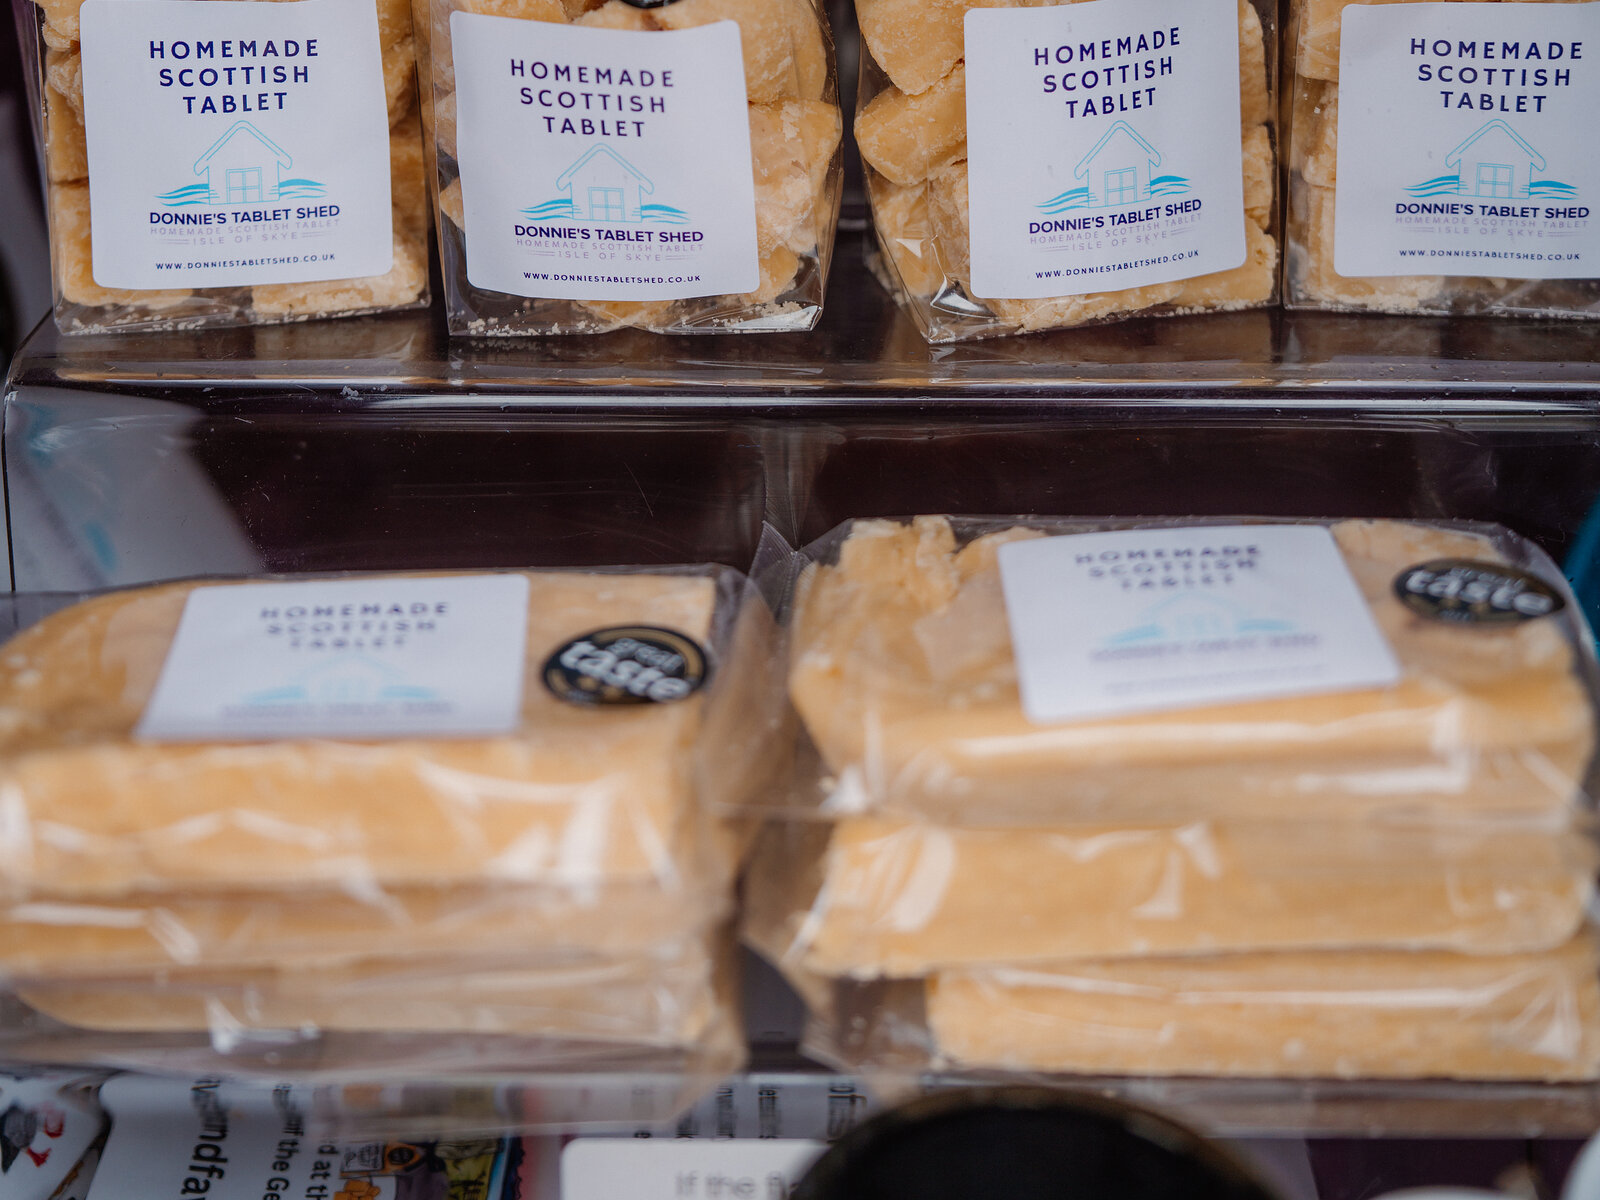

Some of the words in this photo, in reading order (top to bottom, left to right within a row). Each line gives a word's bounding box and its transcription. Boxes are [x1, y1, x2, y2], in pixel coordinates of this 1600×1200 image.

[149, 39, 318, 60] HOMEMADE
[1034, 26, 1180, 66] HOMEMADE
[1410, 38, 1582, 60] HOMEMADE
[159, 65, 308, 87] SCOTTISH
[510, 58, 674, 88] HOMEMADE
[1043, 56, 1172, 93] SCOTTISH
[1418, 64, 1570, 86] SCOTTISH
[182, 92, 288, 114] TABLET
[520, 87, 665, 113] SCOTTISH
[1065, 87, 1156, 118] TABLET
[1440, 91, 1546, 113] TABLET
[542, 116, 645, 138] TABLET
[149, 212, 227, 225] DONNIE'S
[232, 208, 291, 224] TABLET
[296, 205, 340, 219] SHED
[1029, 216, 1105, 234] DONNIE'S
[1109, 207, 1162, 226] TABLET
[1165, 199, 1202, 216] SHED
[1395, 203, 1474, 215] DONNIE'S
[1479, 205, 1540, 218] TABLET
[1544, 207, 1590, 218] SHED
[150, 226, 222, 236] HOMEMADE
[227, 222, 289, 234] SCOTTISH
[296, 218, 340, 230] TABLET
[1030, 230, 1099, 244] HOMEMADE
[1105, 222, 1160, 237] SCOTTISH
[1165, 213, 1202, 227] TABLET
[1396, 216, 1467, 225] HOMEMADE
[1474, 218, 1536, 227] SCOTTISH
[1543, 220, 1589, 229] TABLET
[1480, 227, 1498, 235] OF
[1508, 229, 1544, 238] SKYE
[193, 236, 225, 246] ISLE
[234, 234, 253, 244] OF
[262, 231, 298, 242] SKYE
[514, 225, 591, 240] DONNIE'S
[595, 229, 654, 242] TABLET
[659, 231, 704, 242] SHED
[1072, 240, 1102, 251] ISLE
[1111, 237, 1128, 247] OF
[1136, 230, 1168, 243] SKYE
[516, 238, 585, 249] HOMEMADE
[592, 242, 652, 252] SCOTTISH
[659, 243, 705, 253] TABLET
[1399, 249, 1581, 261] WWW.DONNIESTABLETSHED.CO.UK
[155, 253, 336, 270] WWW.DONNIESTABLETSHED.CO.UK
[558, 251, 590, 260] ISLE
[599, 251, 616, 260] OF
[626, 252, 662, 262] SKYE
[1035, 250, 1200, 279] WWW.DONNIESTABLETSHED.CO.UK
[523, 271, 701, 285] WWW.DONNIESTABLETSHED.CO.UK
[259, 601, 448, 620] HOMEMADE
